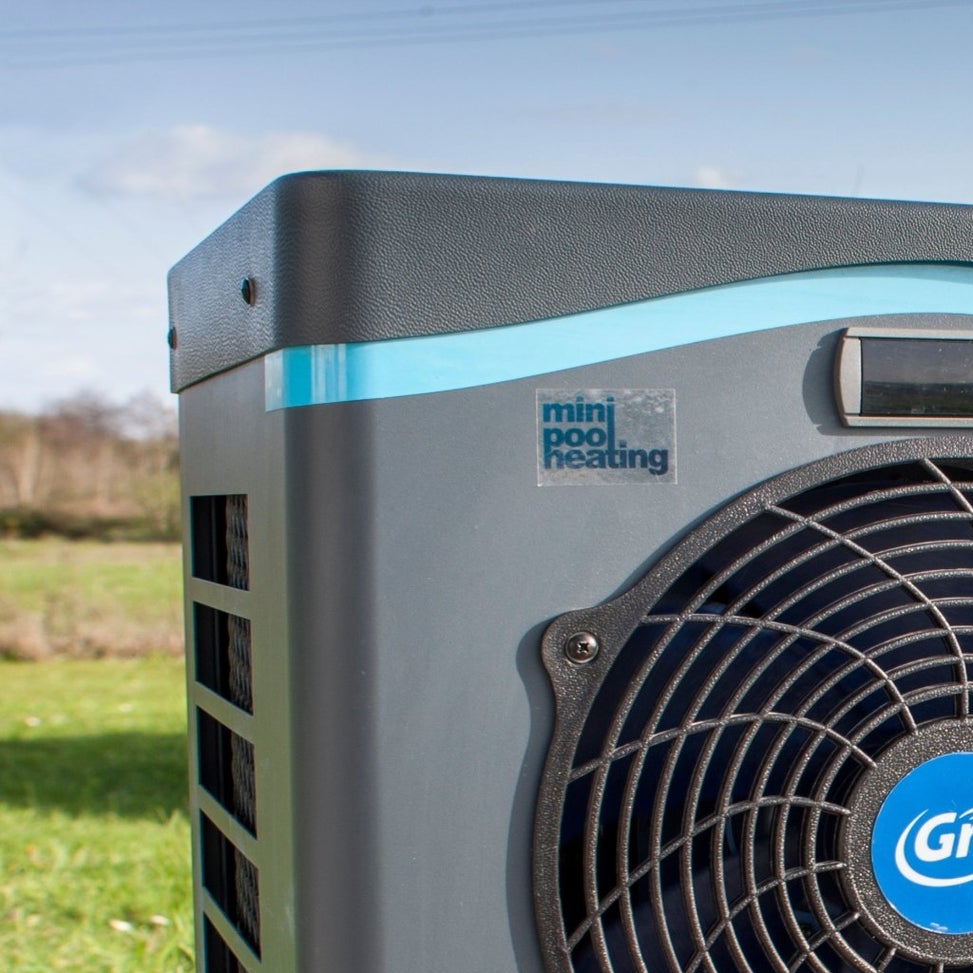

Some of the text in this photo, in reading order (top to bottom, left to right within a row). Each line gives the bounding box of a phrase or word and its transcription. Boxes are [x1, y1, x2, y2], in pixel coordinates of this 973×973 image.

[543, 396, 614, 422] mini
[543, 425, 615, 452] pool
[543, 440, 669, 475] heating
